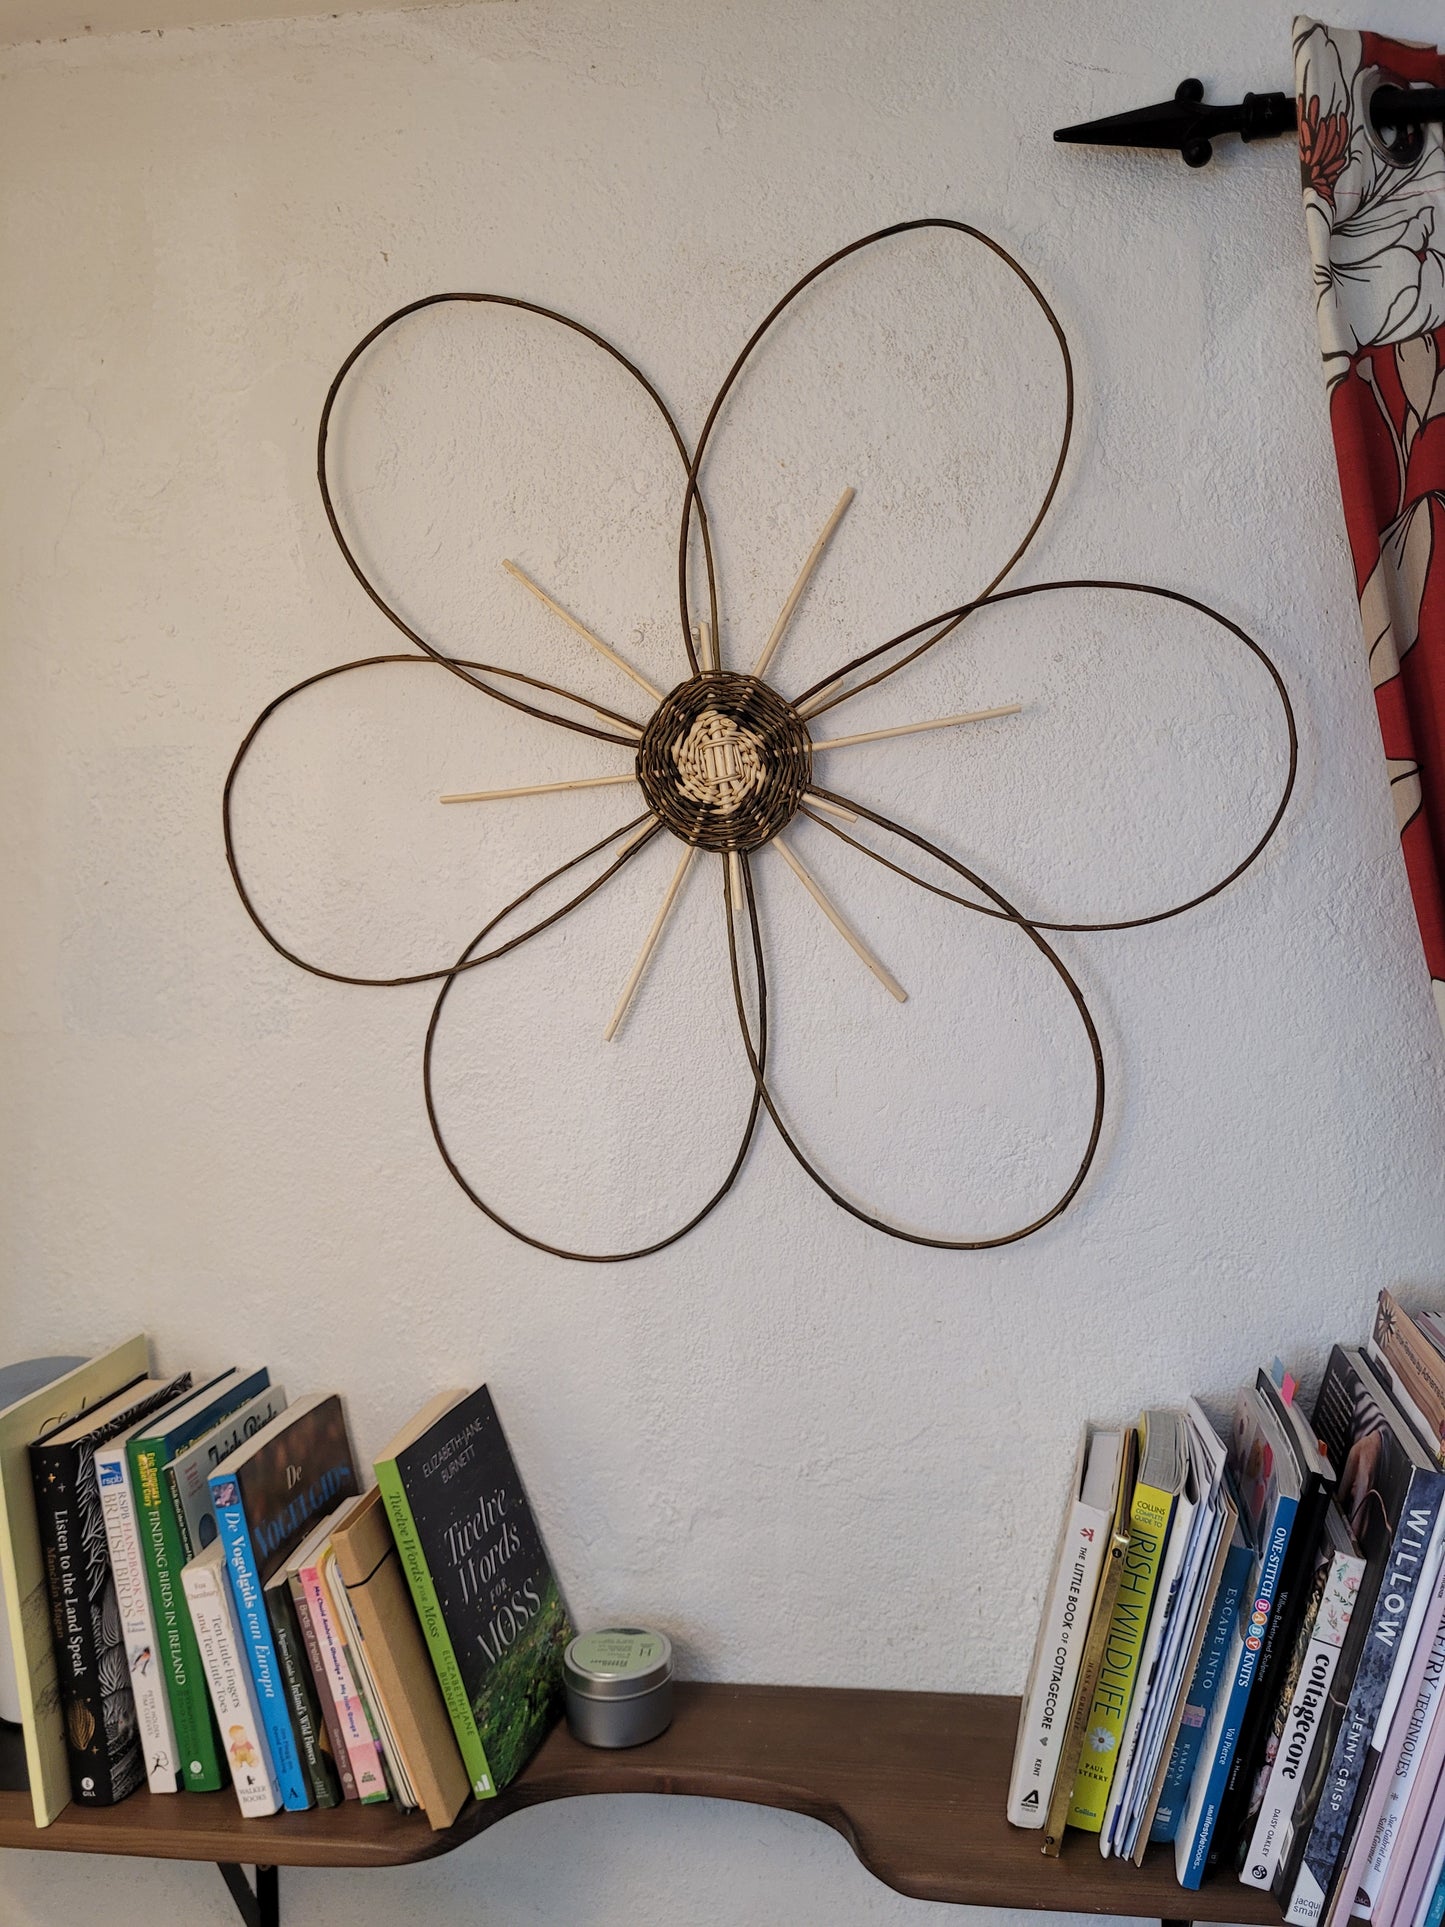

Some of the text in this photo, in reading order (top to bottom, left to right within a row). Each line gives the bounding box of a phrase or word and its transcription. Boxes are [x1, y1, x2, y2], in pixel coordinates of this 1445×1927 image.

[146, 1451, 157, 1465] Eric
[422, 1417, 483, 1478] ELIZABETH-JANE
[441, 1444, 476, 1484] BURNETT
[102, 1477, 123, 1485] rspb
[286, 1465, 302, 1491] De
[444, 1487, 507, 1567] Twelve
[1134, 1515, 1162, 1528] GUIDE TO
[1136, 1508, 1163, 1521] COMPLETE
[1137, 1501, 1165, 1515] COLLINS
[102, 1493, 133, 1617] BRITISH BIRDS
[117, 1490, 144, 1612] RSPB HANDBOOK OF
[389, 1491, 441, 1637] Twelve Words FOR Moss
[458, 1522, 521, 1605] Words
[1120, 1528, 1159, 1594] IRISH
[54, 1510, 86, 1675] Listen to the Land Speak
[490, 1577, 508, 1604] FOR
[1375, 1509, 1430, 1645] WILLOW
[148, 1510, 186, 1684] FINDING BIRDS IN IRELAND
[224, 1511, 274, 1697] De Vogelgids van Europa
[1214, 1588, 1237, 1644] ESCAPE
[1236, 1526, 1287, 1687] ONE-STITCH BABY KNITS
[1276, 1591, 1287, 1613] Willow
[298, 1603, 322, 1672] Birds of Ireland
[476, 1577, 541, 1665] MOSS
[1041, 1546, 1087, 1728] THE LITTLE BOOK OF COTTAGECORE
[1268, 1614, 1281, 1639] Basketry
[196, 1613, 227, 1713] and Ten Little Toes
[211, 1617, 239, 1708] Ten Little Fingers
[284, 1659, 294, 1676] Guide
[1083, 1662, 1095, 1684] HANS
[1093, 1603, 1141, 1718] WILDLIFE
[1202, 1651, 1220, 1688] INTO
[1257, 1653, 1271, 1681] Sculpture
[290, 1682, 307, 1716] Ireland's
[338, 1683, 345, 1694] My
[342, 1695, 351, 1710] Irish
[439, 1671, 461, 1719] BURNETT
[442, 1650, 474, 1735] ELIZABETH-JANE
[298, 1715, 311, 1735] Wild
[1282, 1654, 1329, 1778] cottagecore
[1394, 1692, 1430, 1776] TECHNIQUES
[303, 1735, 318, 1765] Flowers
[1166, 1745, 1179, 1778] JONES
[1173, 1743, 1190, 1785] RAMONA
[1218, 1727, 1235, 1765] Val Pierce
[1330, 1713, 1364, 1810] JENNY CRISP
[1032, 1758, 1041, 1776] KENT
[1079, 1769, 1108, 1782] STERRY
[1085, 1763, 1104, 1773] PAUL
[239, 1786, 266, 1794] WALKER
[242, 1795, 266, 1803] BOOKS
[1074, 1806, 1097, 1817] Collins
[1375, 1815, 1387, 1835] Sally
[1261, 1808, 1280, 1856] DAISY OAKLEY
[1373, 1814, 1397, 1872] Sue Gabriel and
[1293, 1906, 1319, 1918] small
[1295, 1897, 1321, 1910] jacqui
